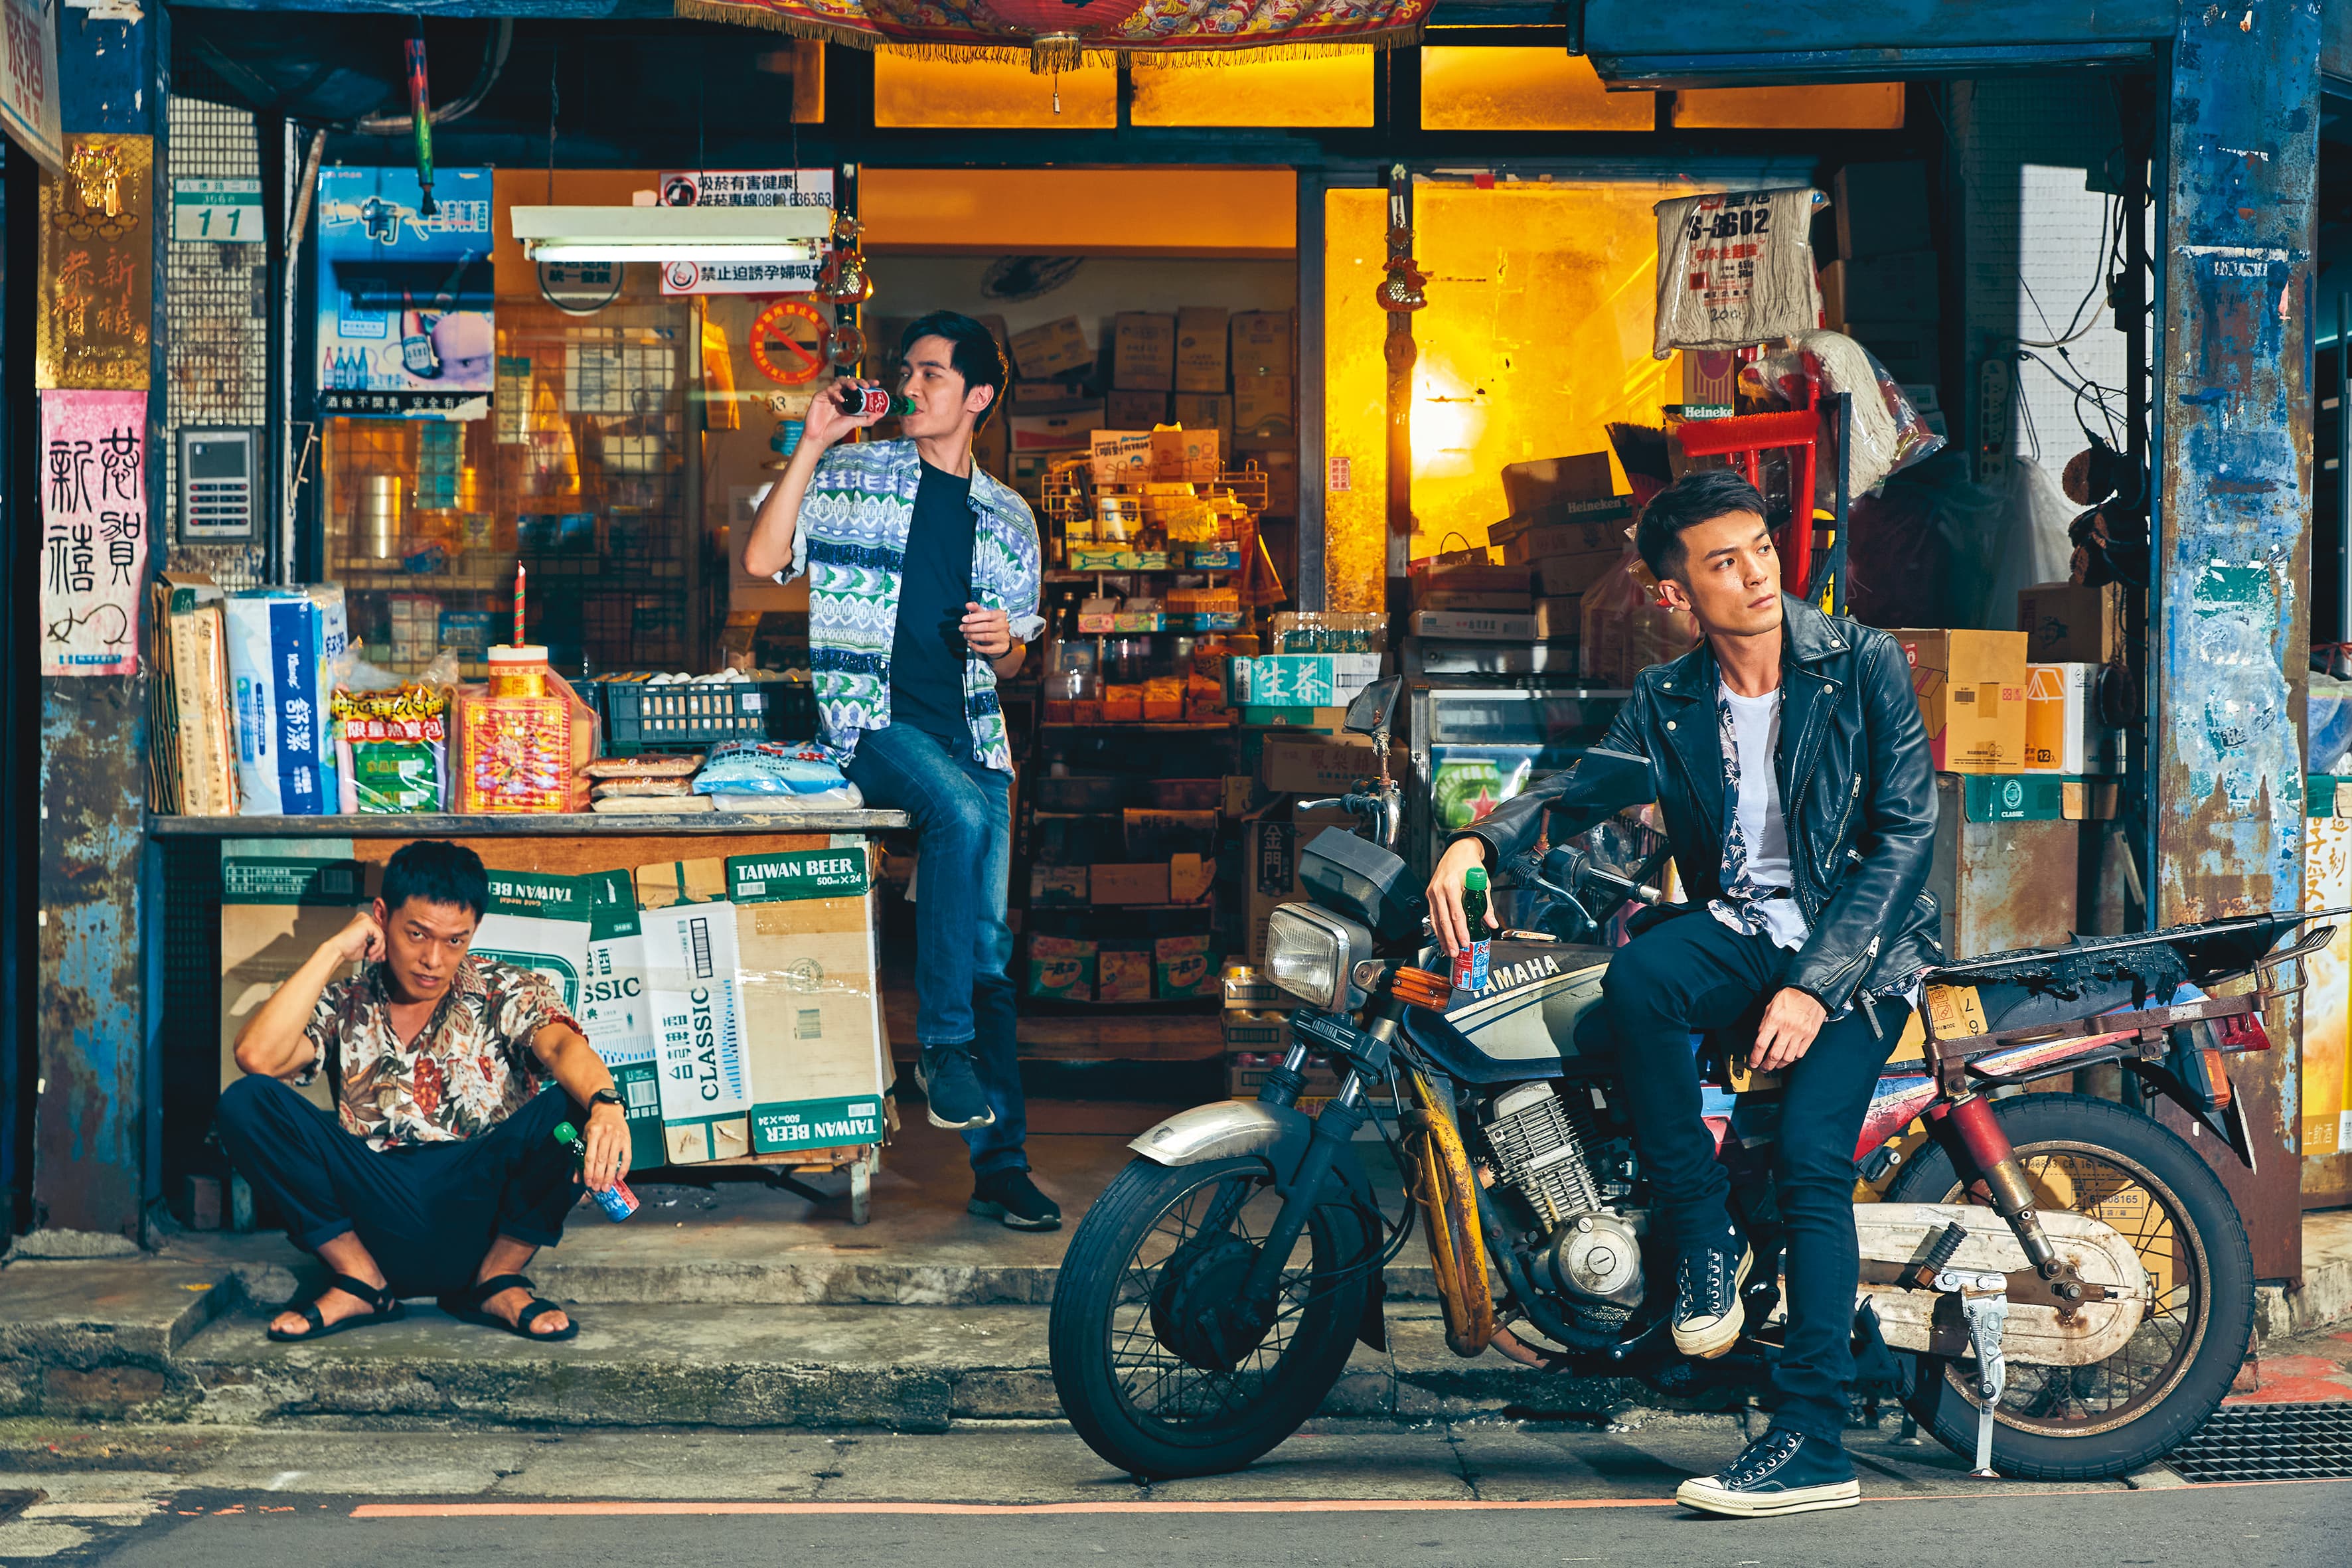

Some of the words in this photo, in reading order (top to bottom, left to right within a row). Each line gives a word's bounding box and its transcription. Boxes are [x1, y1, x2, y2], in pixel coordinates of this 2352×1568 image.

[698, 174, 794, 191] 吸菸有害健康
[198, 208, 241, 237] 11
[1567, 498, 1622, 514] Heineken
[1258, 659, 1330, 702] 生茶
[285, 697, 311, 751] 舒潔
[1263, 823, 1283, 879] 金門
[736, 862, 801, 881] TAIWAN
[806, 858, 854, 876] BEER
[817, 876, 840, 886] 500ml
[516, 884, 574, 902] TAIWAN
[1312, 1019, 1338, 1040] YAMAHA
[690, 986, 719, 1101] CLASSIC
[758, 1116, 769, 1126] 24
[815, 1119, 877, 1138] TAIWAN
[765, 1124, 810, 1142] BEER
[2303, 1123, 2333, 1146] 止飲酒
